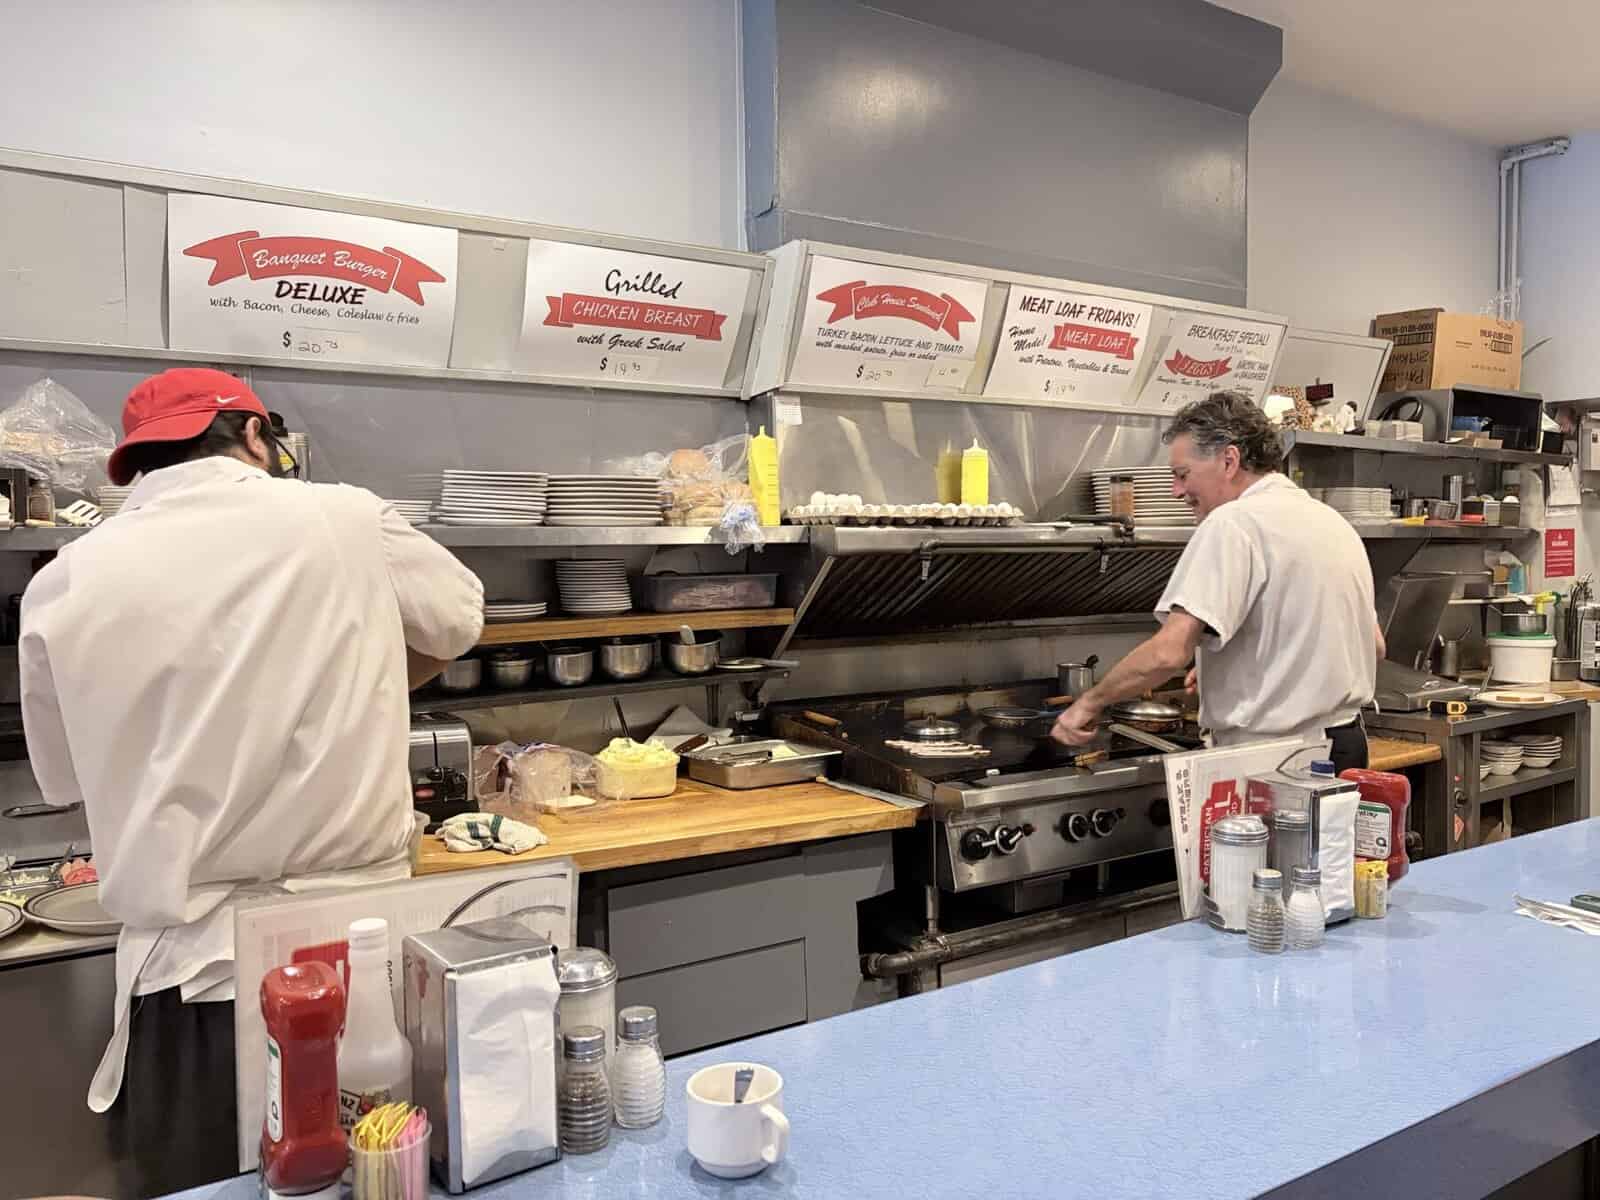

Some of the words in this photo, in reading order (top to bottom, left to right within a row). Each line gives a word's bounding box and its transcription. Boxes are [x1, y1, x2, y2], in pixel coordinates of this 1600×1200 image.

[252, 249, 326, 270] Banquet
[332, 251, 388, 280] Burger
[275, 280, 366, 305] DELUXE
[605, 269, 683, 299] Grilled
[209, 297, 238, 308] with
[243, 299, 283, 313] Bacon,
[290, 303, 330, 318] Cheese,
[337, 307, 384, 321] Coleslaw
[386, 312, 394, 322] &
[396, 313, 420, 325] fries
[572, 300, 640, 322] CHICKEN
[644, 309, 702, 329] BREAST
[1019, 295, 1054, 314] MEAT
[1054, 301, 1087, 319] LOAF
[1087, 306, 1141, 329] FRIDAYS!
[282, 331, 291, 348] $
[577, 333, 604, 345] with
[608, 334, 643, 350] Greek
[646, 337, 686, 352] Salad
[817, 327, 849, 341] TURKEY
[850, 331, 878, 344] BACON
[879, 335, 913, 348] LETTUCE
[916, 340, 931, 351] AND
[934, 342, 965, 355] TOMATO
[1009, 326, 1036, 338] Home
[1014, 335, 1047, 351] Made!
[1063, 330, 1097, 346] MEAT
[1098, 335, 1128, 350] LOAF
[1187, 324, 1239, 343] BREAKFAST
[600, 357, 608, 371] $
